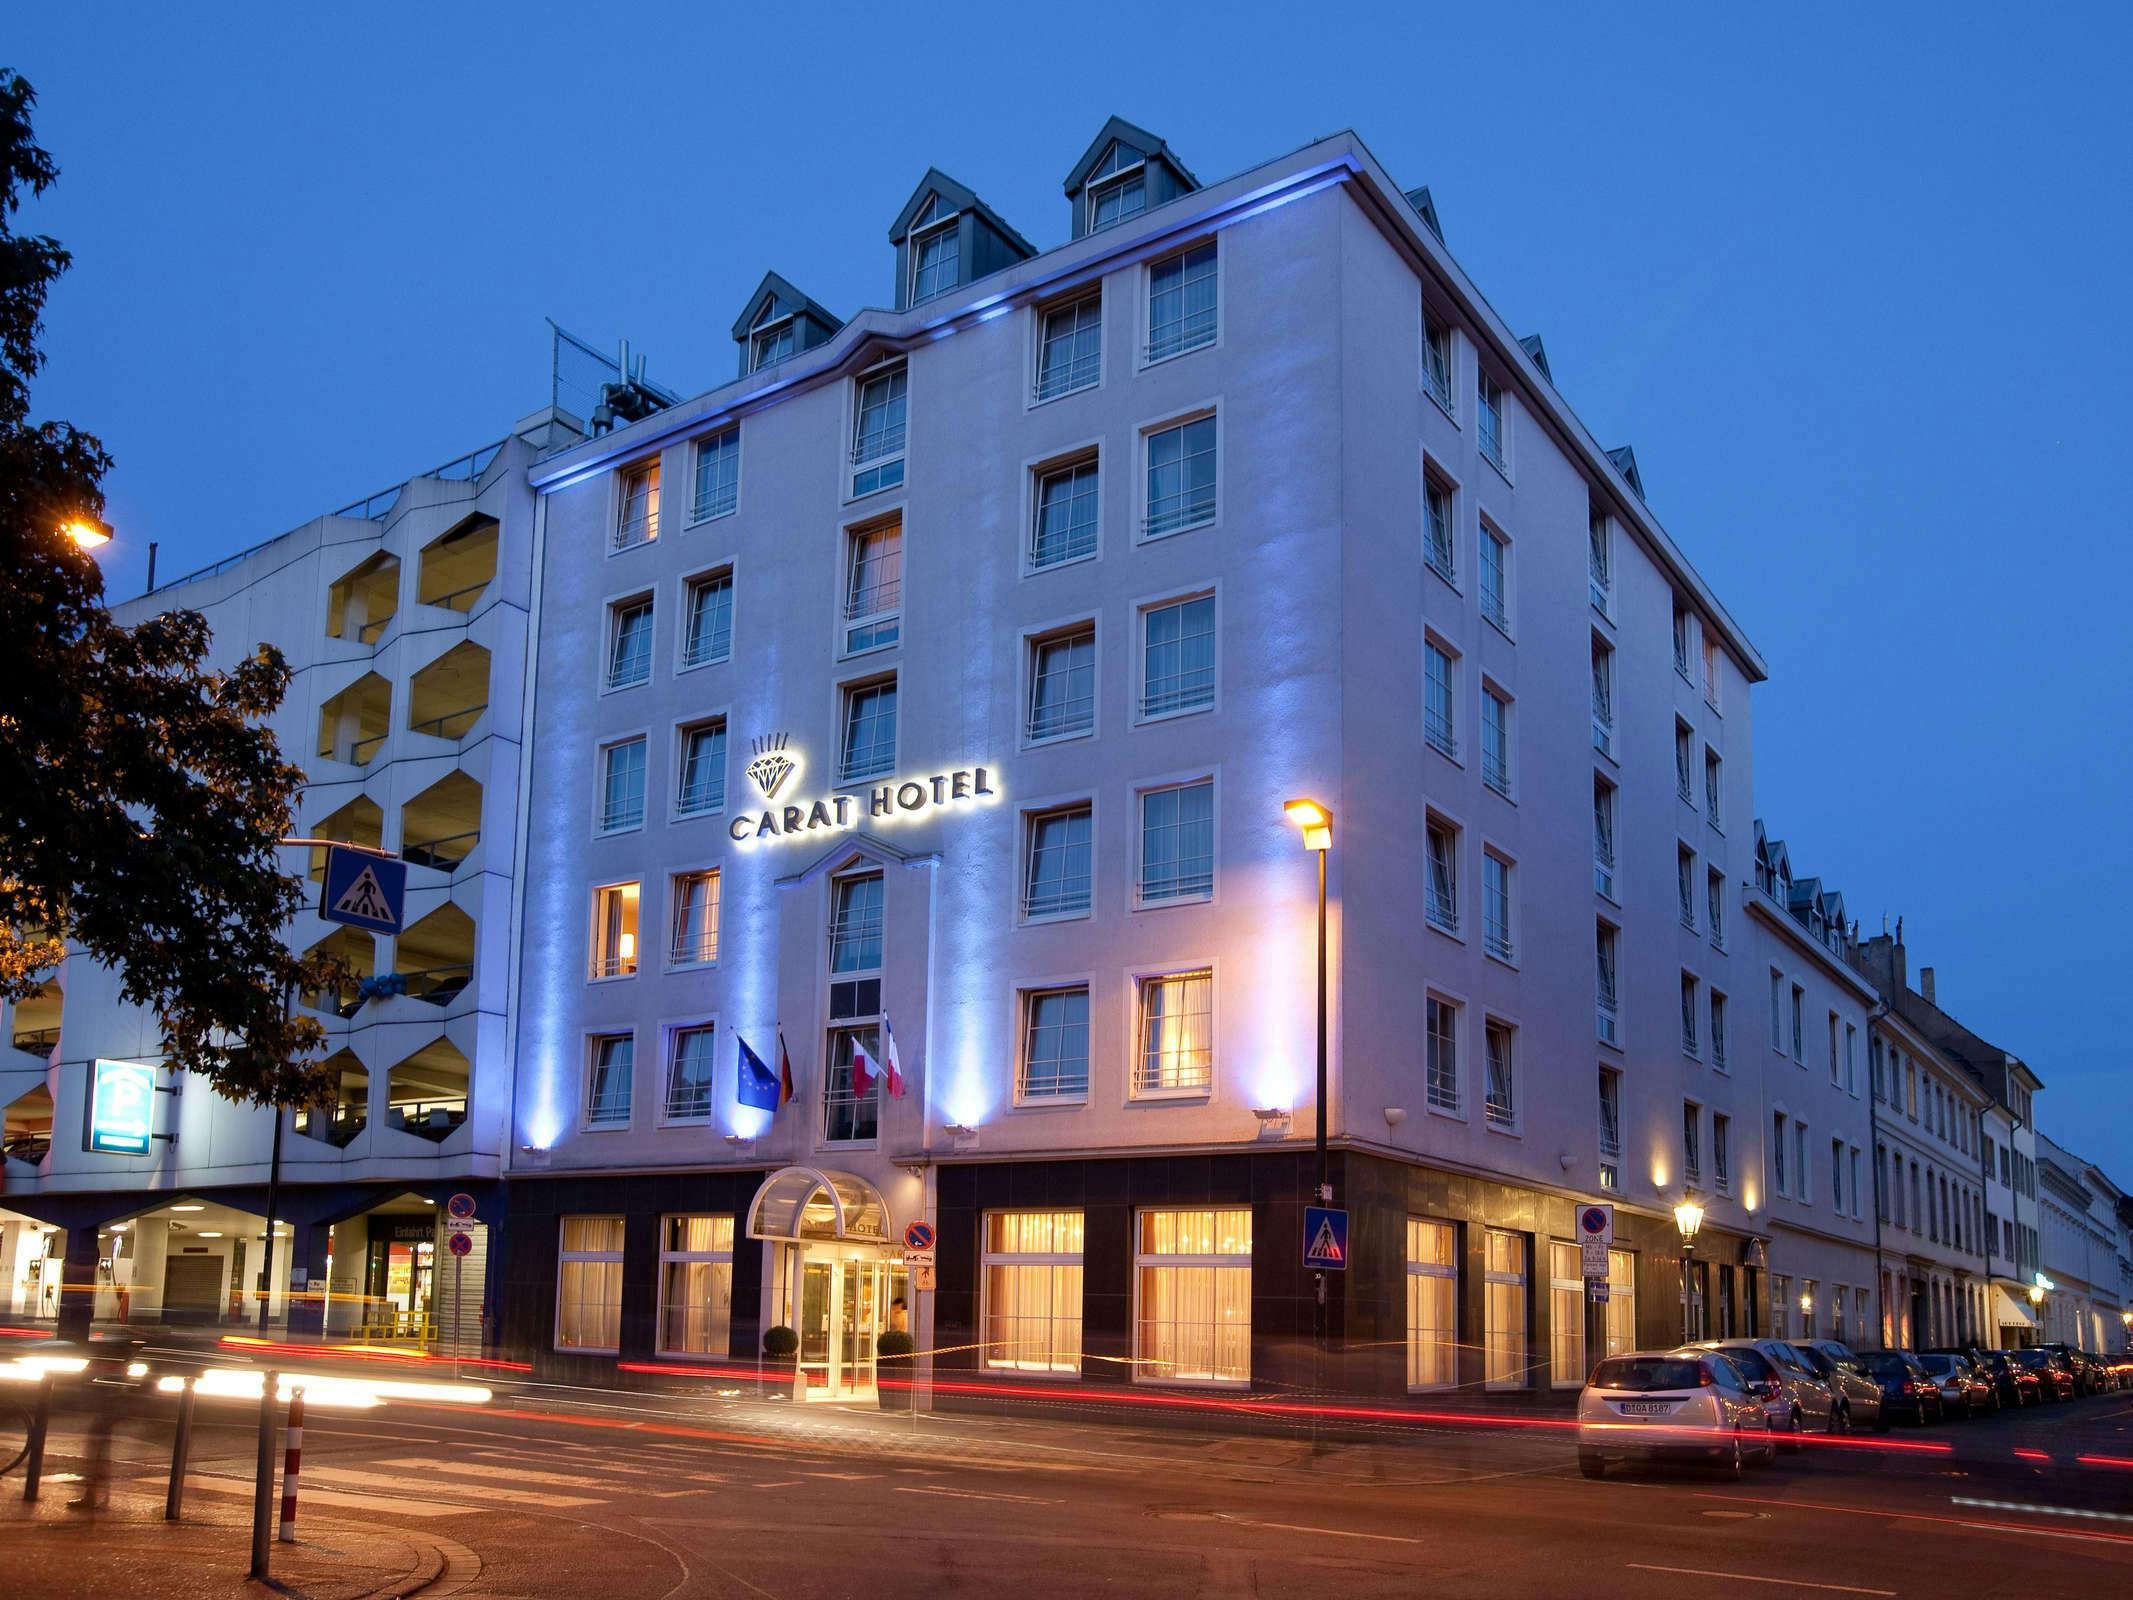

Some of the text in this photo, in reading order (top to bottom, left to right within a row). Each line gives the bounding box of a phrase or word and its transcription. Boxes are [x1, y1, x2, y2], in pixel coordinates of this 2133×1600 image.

[729, 767, 994, 841] CARAT HOTEL
[111, 1083, 140, 1117] P
[1585, 1234, 1604, 1242] ZONE
